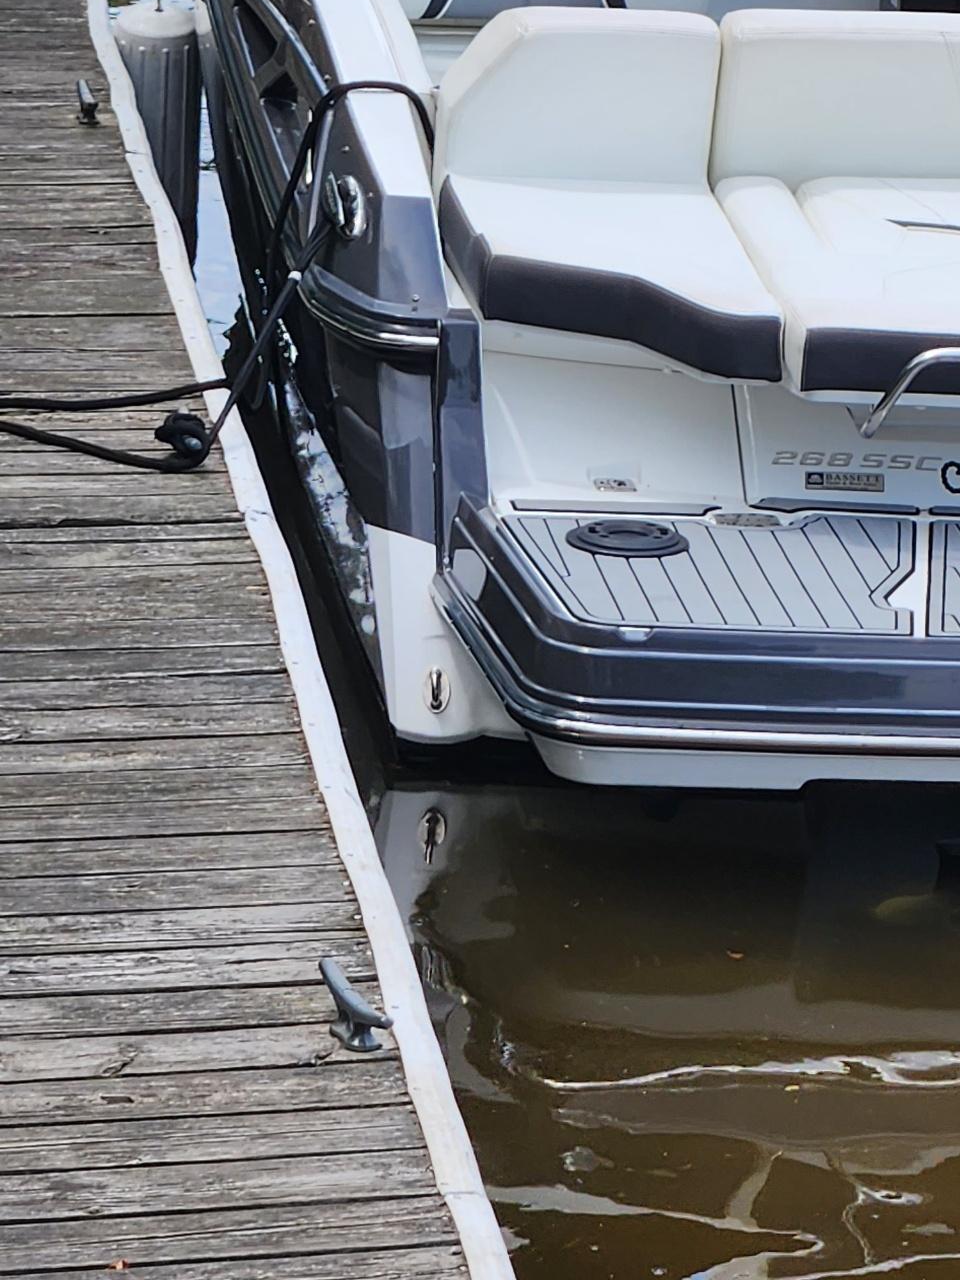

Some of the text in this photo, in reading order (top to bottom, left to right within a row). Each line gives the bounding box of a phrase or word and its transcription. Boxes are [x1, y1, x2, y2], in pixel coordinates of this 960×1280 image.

[771, 451, 943, 471] 268 SSC
[825, 473, 880, 482] BASSETT
